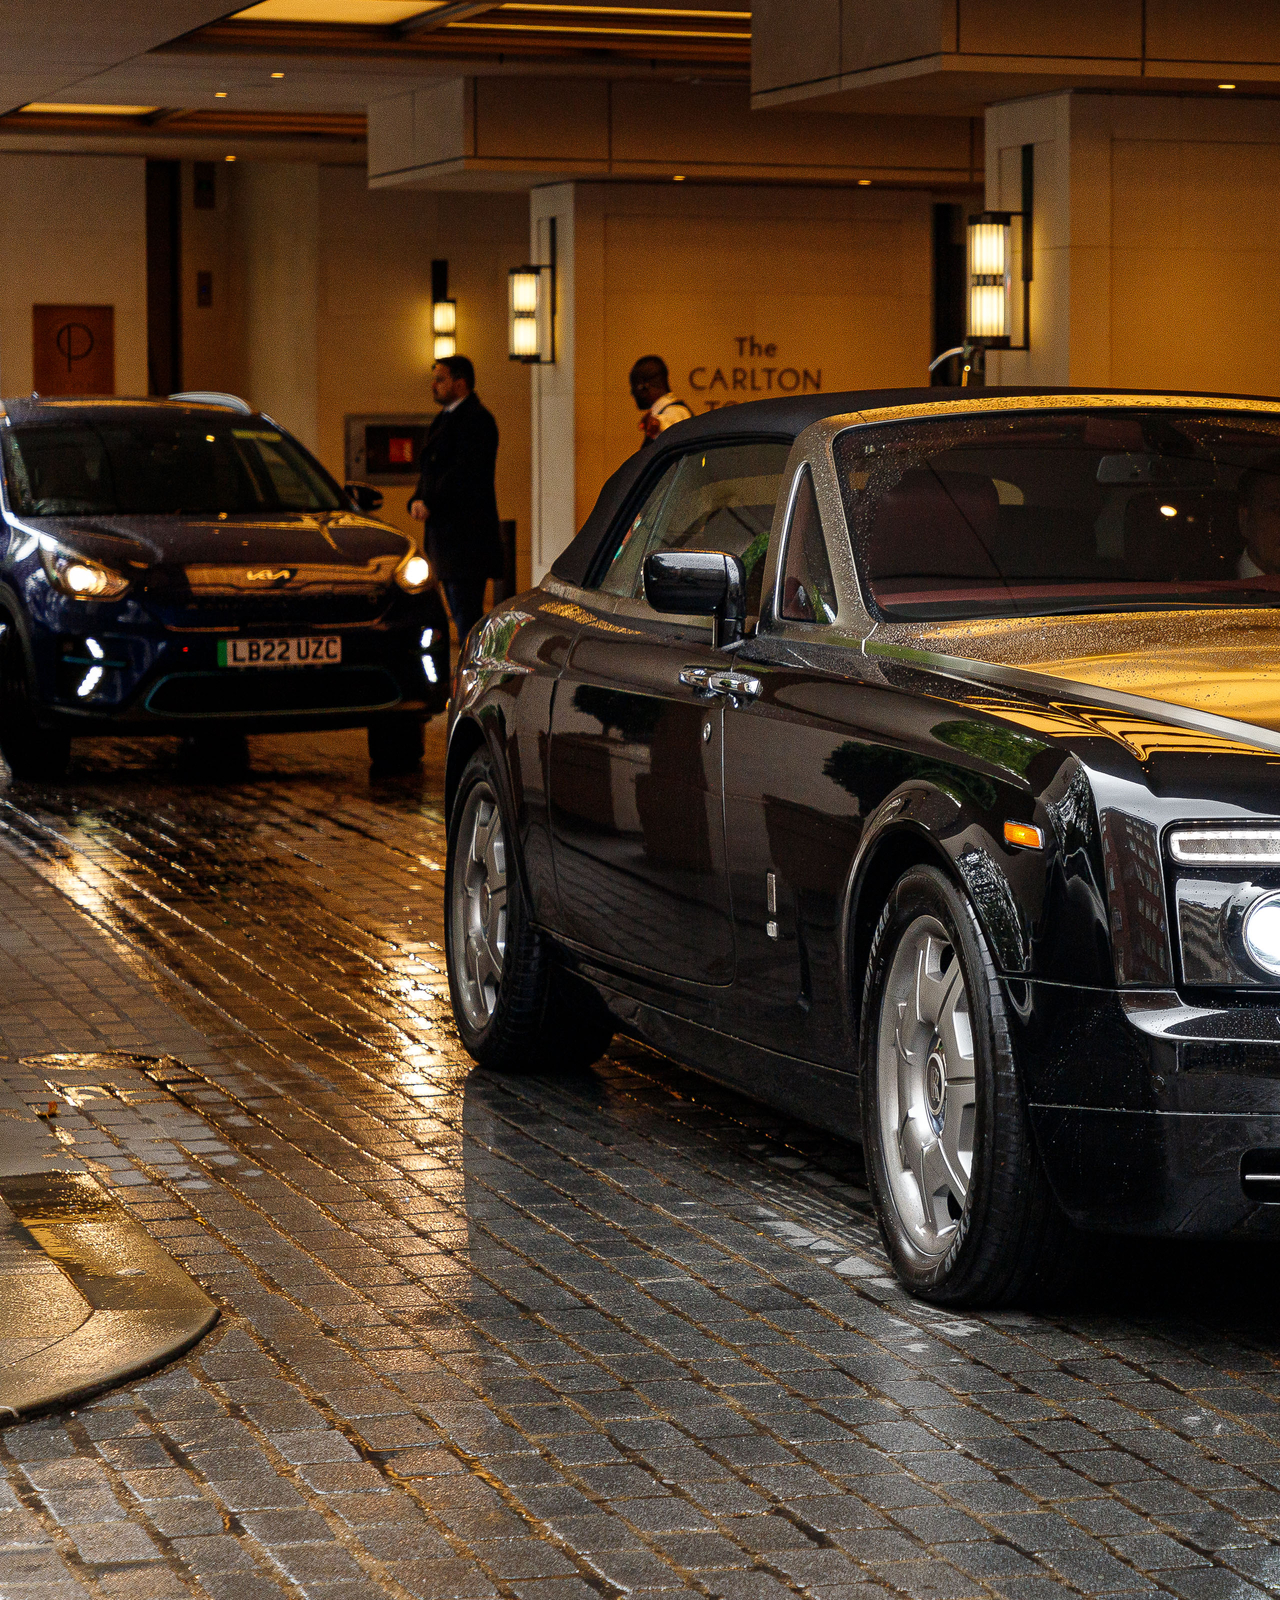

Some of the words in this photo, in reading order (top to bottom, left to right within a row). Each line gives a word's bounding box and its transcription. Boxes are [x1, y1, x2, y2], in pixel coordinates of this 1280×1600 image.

[735, 336, 777, 357] The
[689, 367, 822, 391] CARLTON
[232, 641, 290, 662] LB22
[297, 639, 338, 660] UZC
